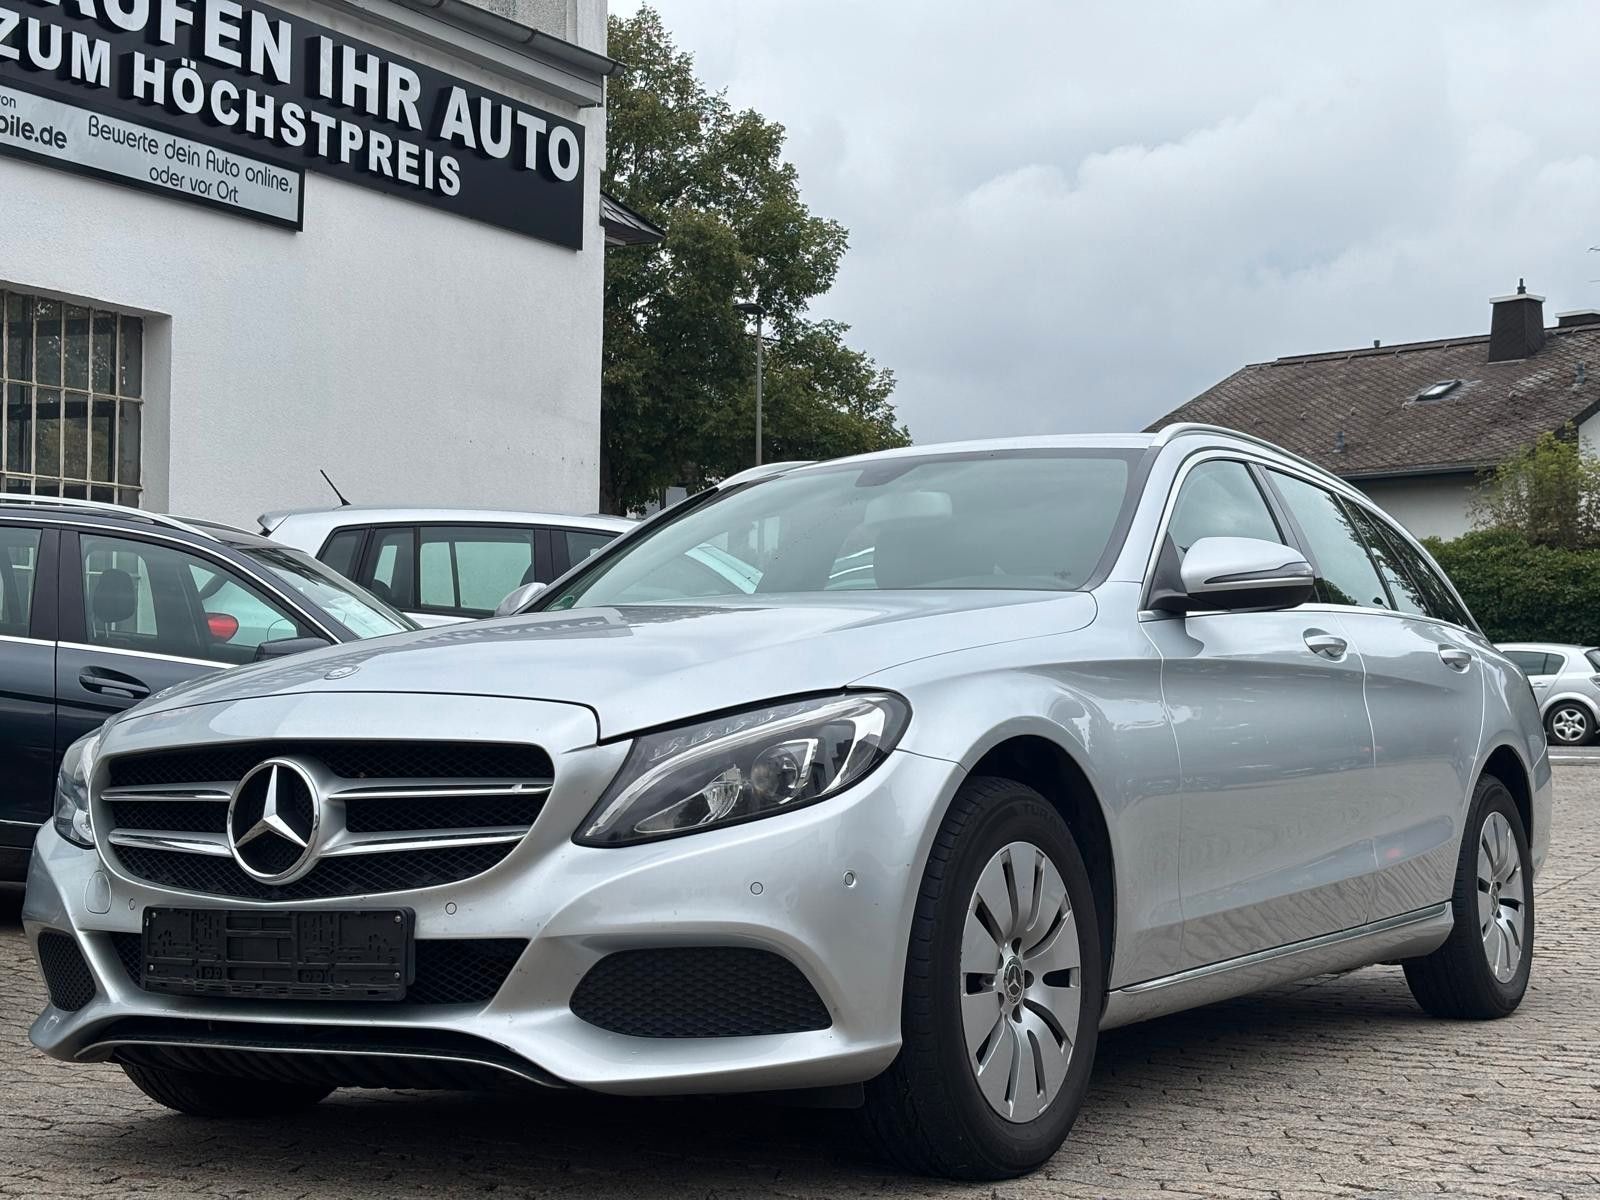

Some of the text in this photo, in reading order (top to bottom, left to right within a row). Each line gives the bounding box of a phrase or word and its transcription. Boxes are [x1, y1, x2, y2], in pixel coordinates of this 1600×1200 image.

[0, 6, 461, 196] ZUM HÖCHSTPREIS
[88, 115, 293, 194] Bewerte dein Auto online,
[320, 35, 422, 131] IHR
[440, 86, 580, 182] AUTO
[149, 165, 239, 204] oder vor Ort
